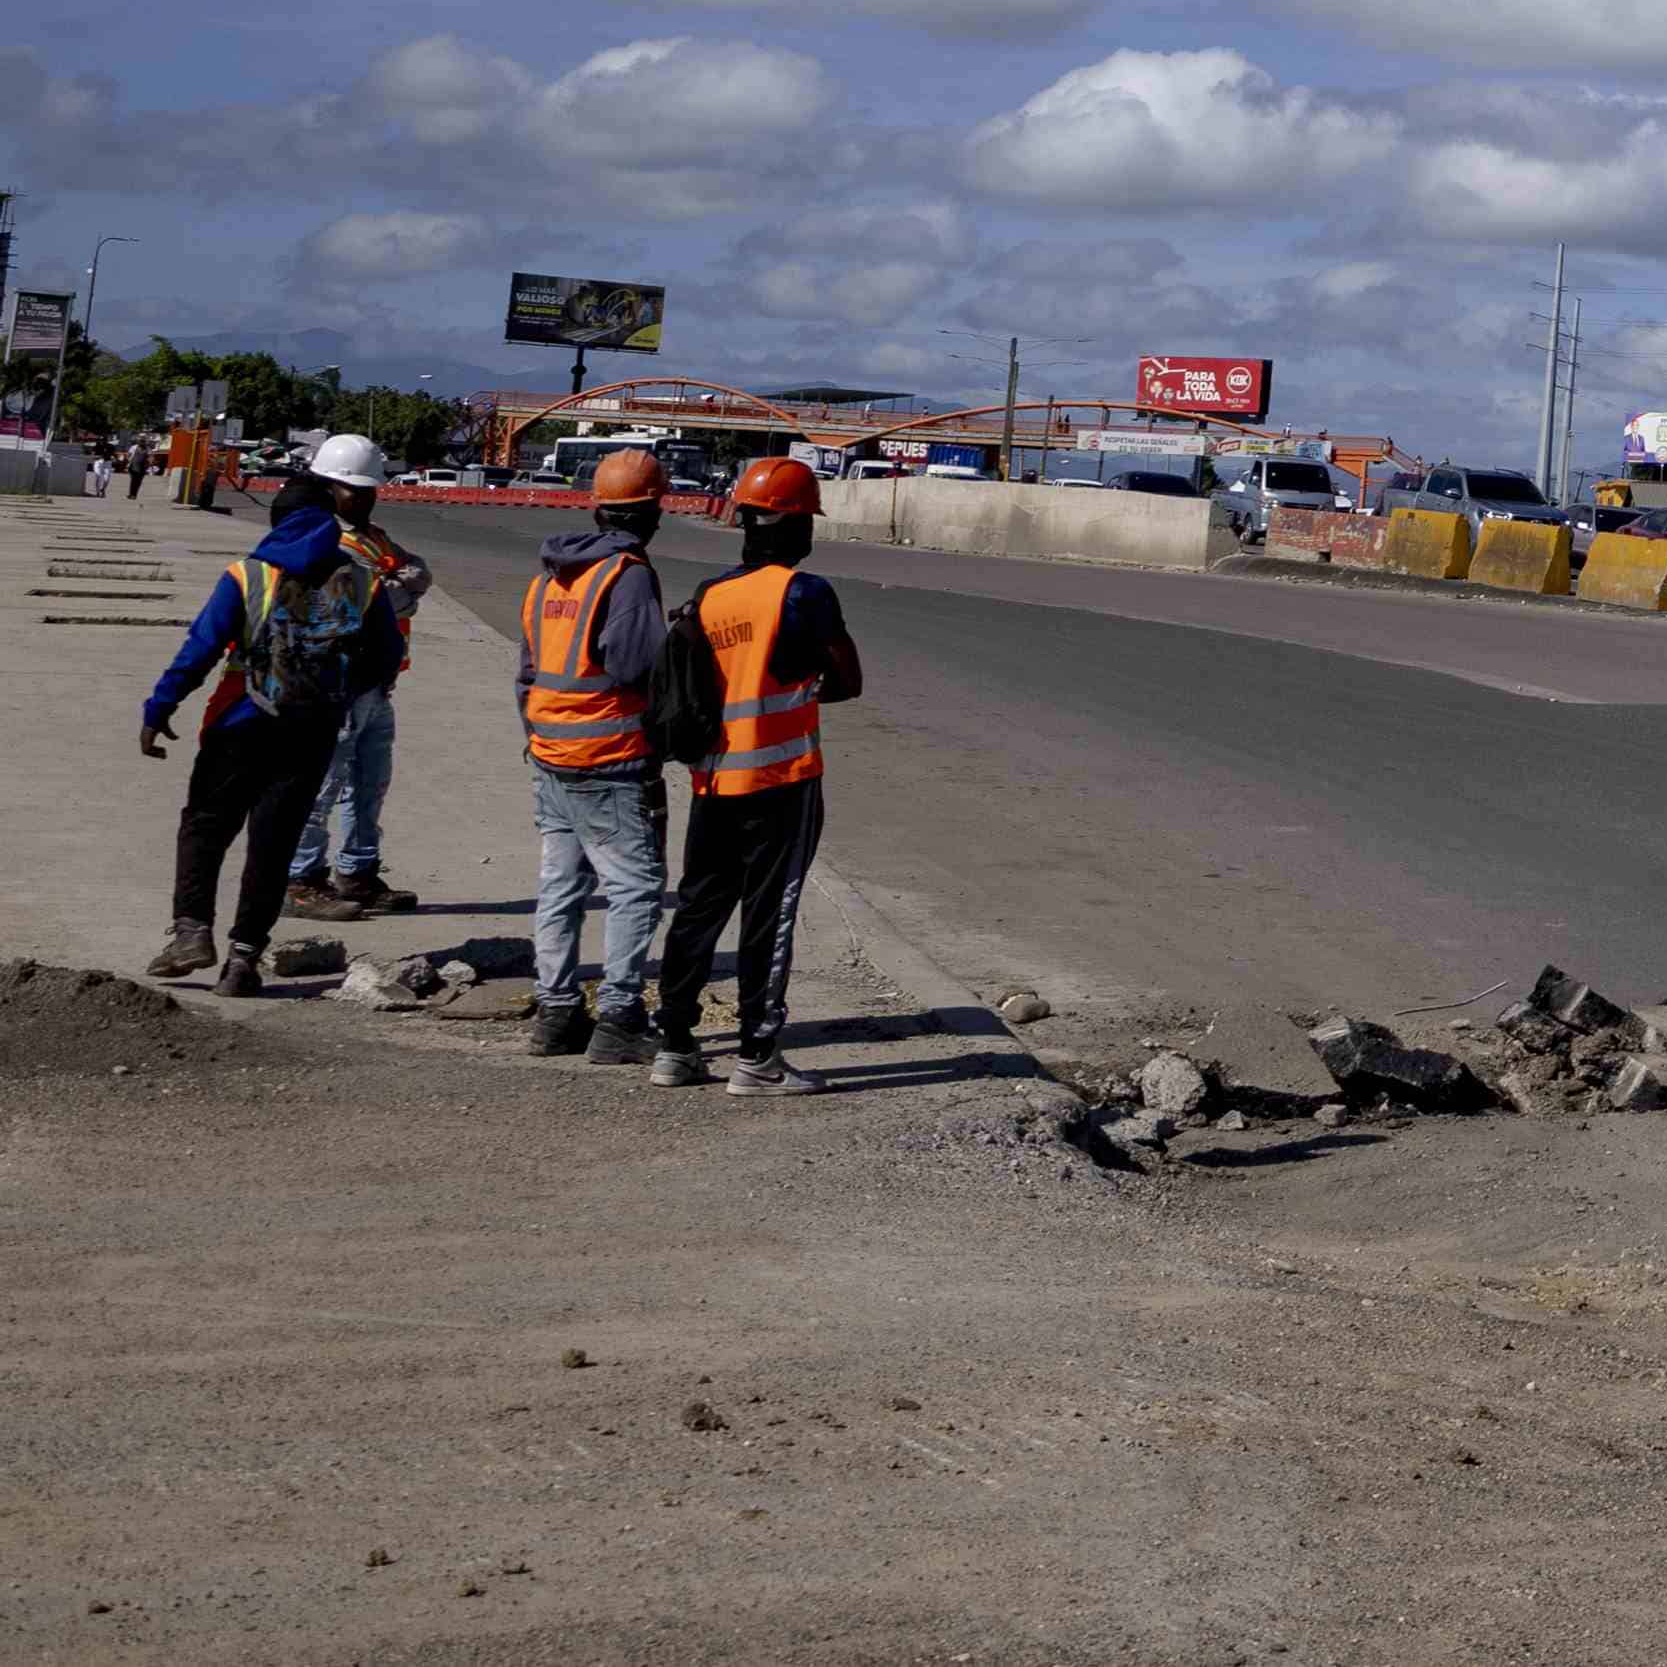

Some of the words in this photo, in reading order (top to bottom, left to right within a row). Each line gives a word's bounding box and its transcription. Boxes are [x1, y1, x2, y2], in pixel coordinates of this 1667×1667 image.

[516, 293, 566, 305] VALIOSO
[1184, 372, 1216, 382] PARA
[1183, 381, 1215, 391] TODA
[1176, 391, 1192, 400] LA
[1194, 391, 1221, 401] VIDA
